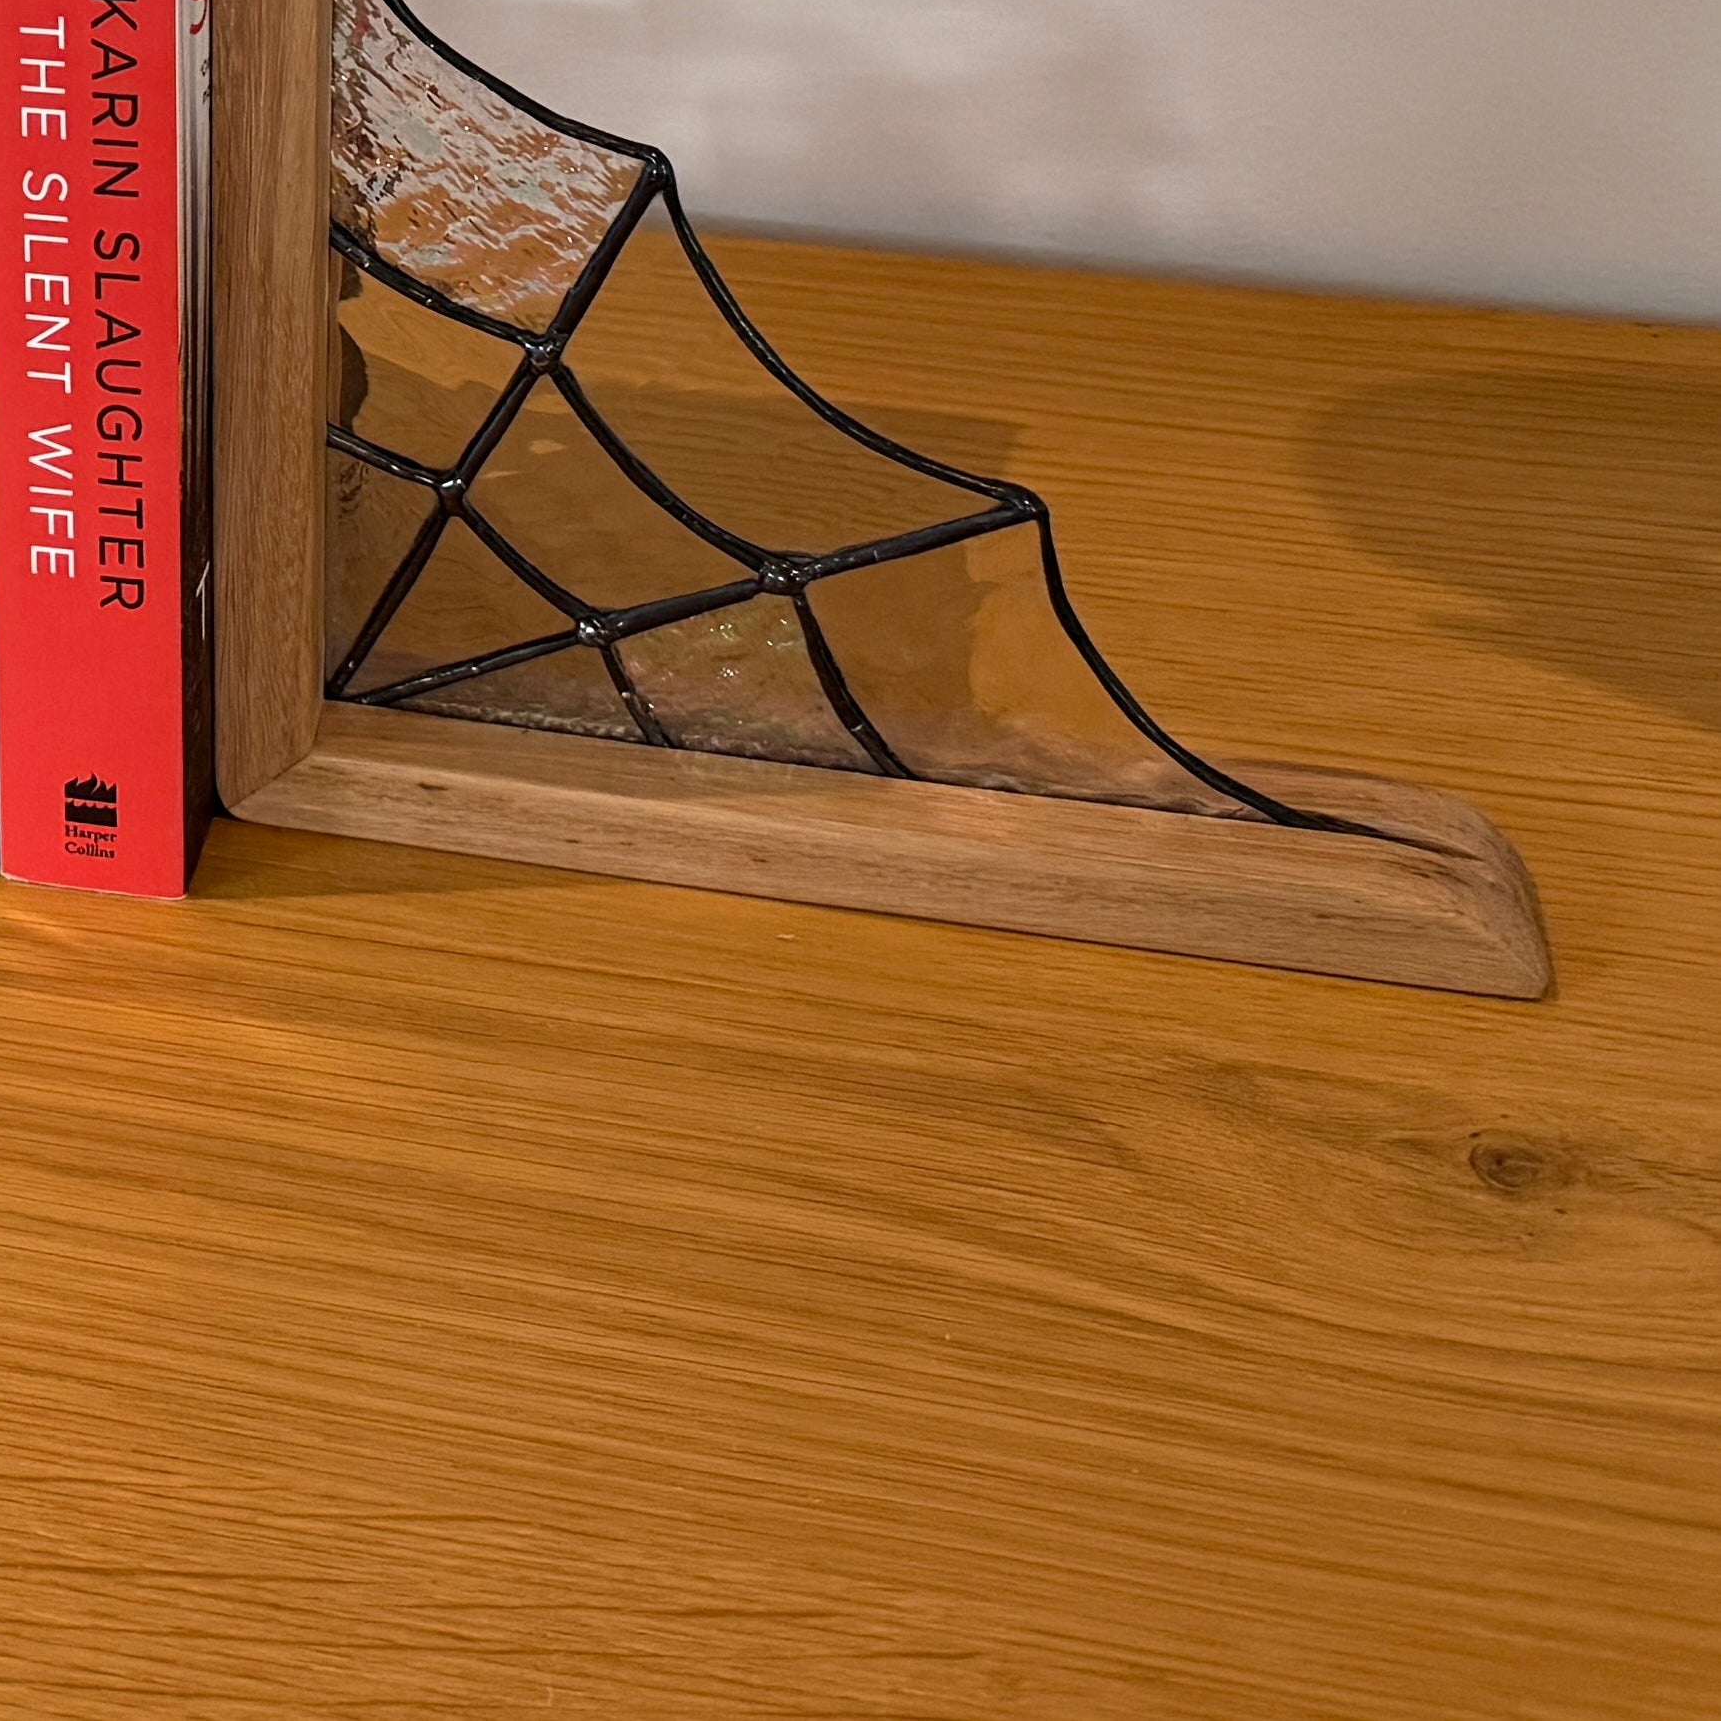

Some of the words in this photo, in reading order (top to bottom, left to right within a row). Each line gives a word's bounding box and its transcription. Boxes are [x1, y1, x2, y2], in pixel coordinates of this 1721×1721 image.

[19, 16, 67, 141] THE
[22, 170, 71, 395] SILENT
[93, 229, 145, 610] SLAUGHTER
[28, 423, 75, 579] WIFE
[64, 824, 118, 843] Harper
[64, 842, 115, 859] Collins
